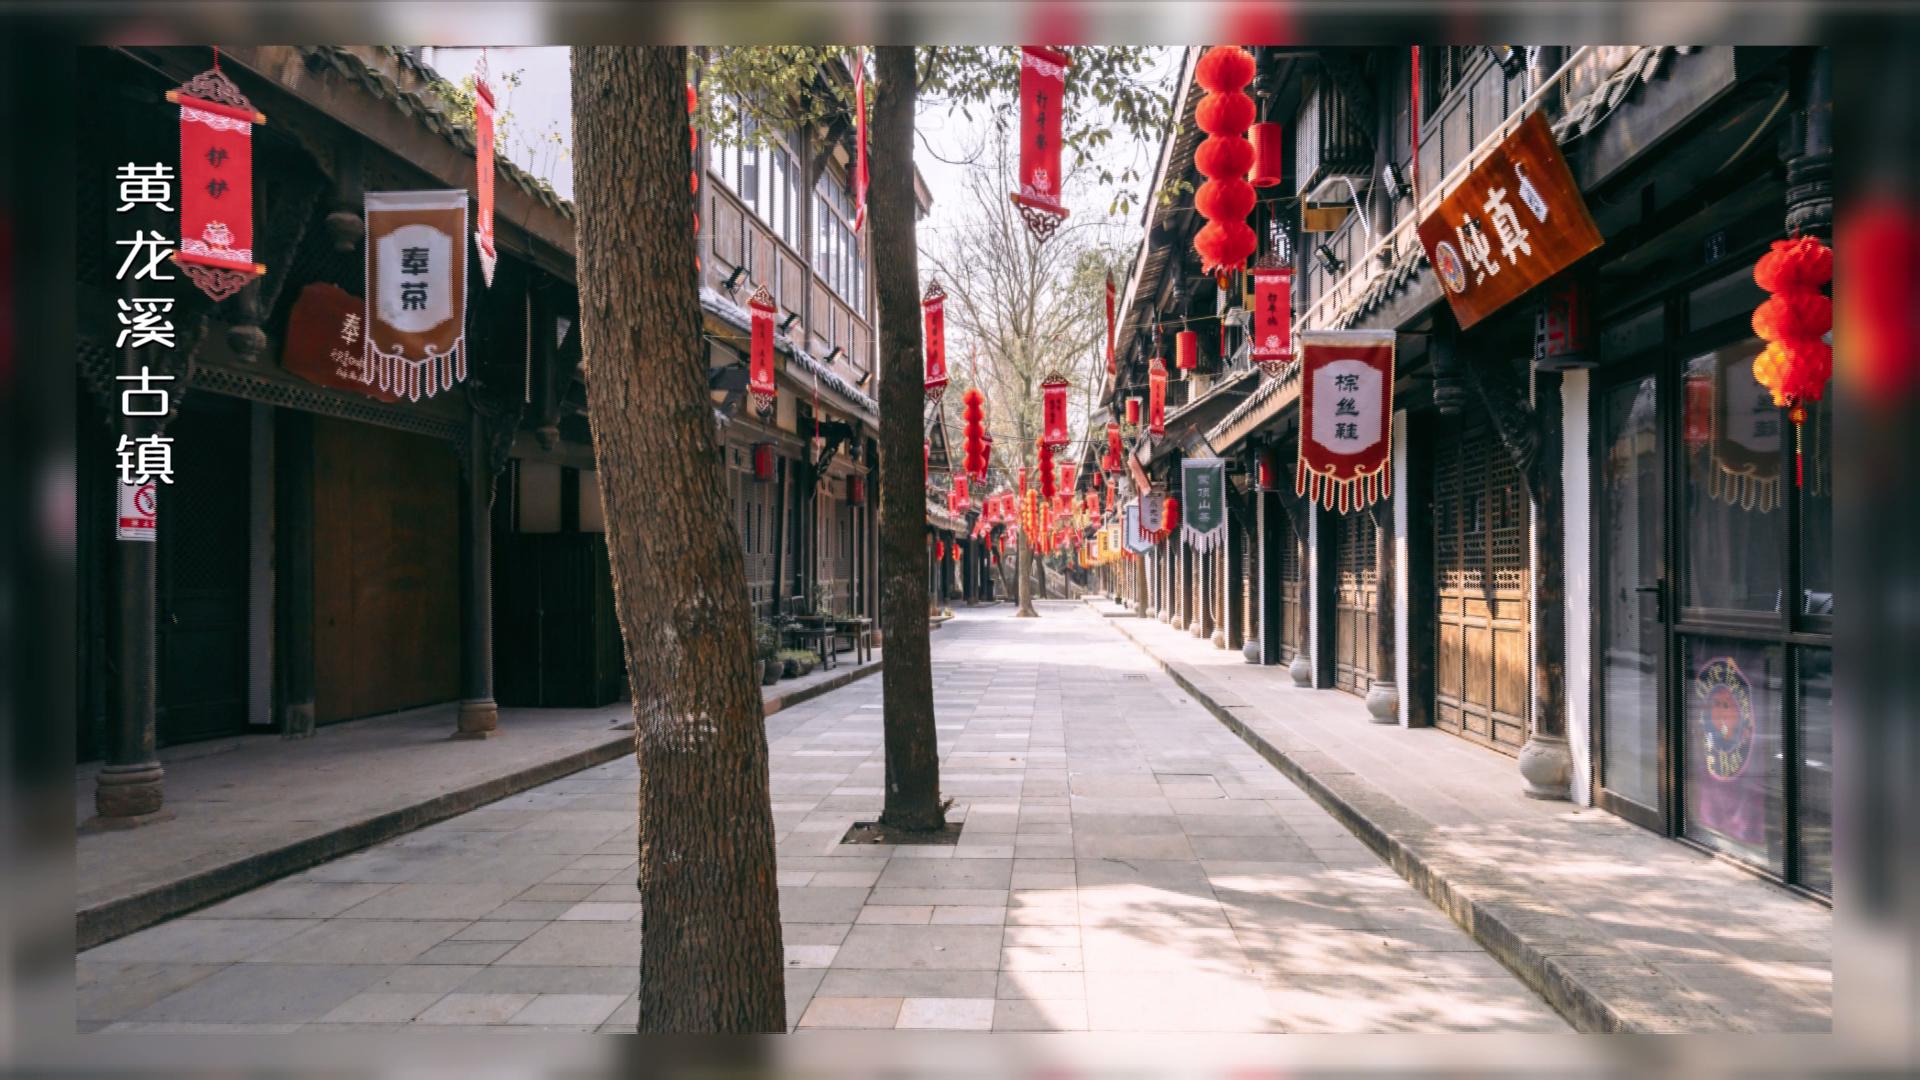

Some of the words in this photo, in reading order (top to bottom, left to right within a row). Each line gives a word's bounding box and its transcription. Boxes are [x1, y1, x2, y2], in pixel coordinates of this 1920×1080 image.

[401, 246, 428, 311] 奉茶
[1335, 373, 1360, 440] 棕丝鞋
